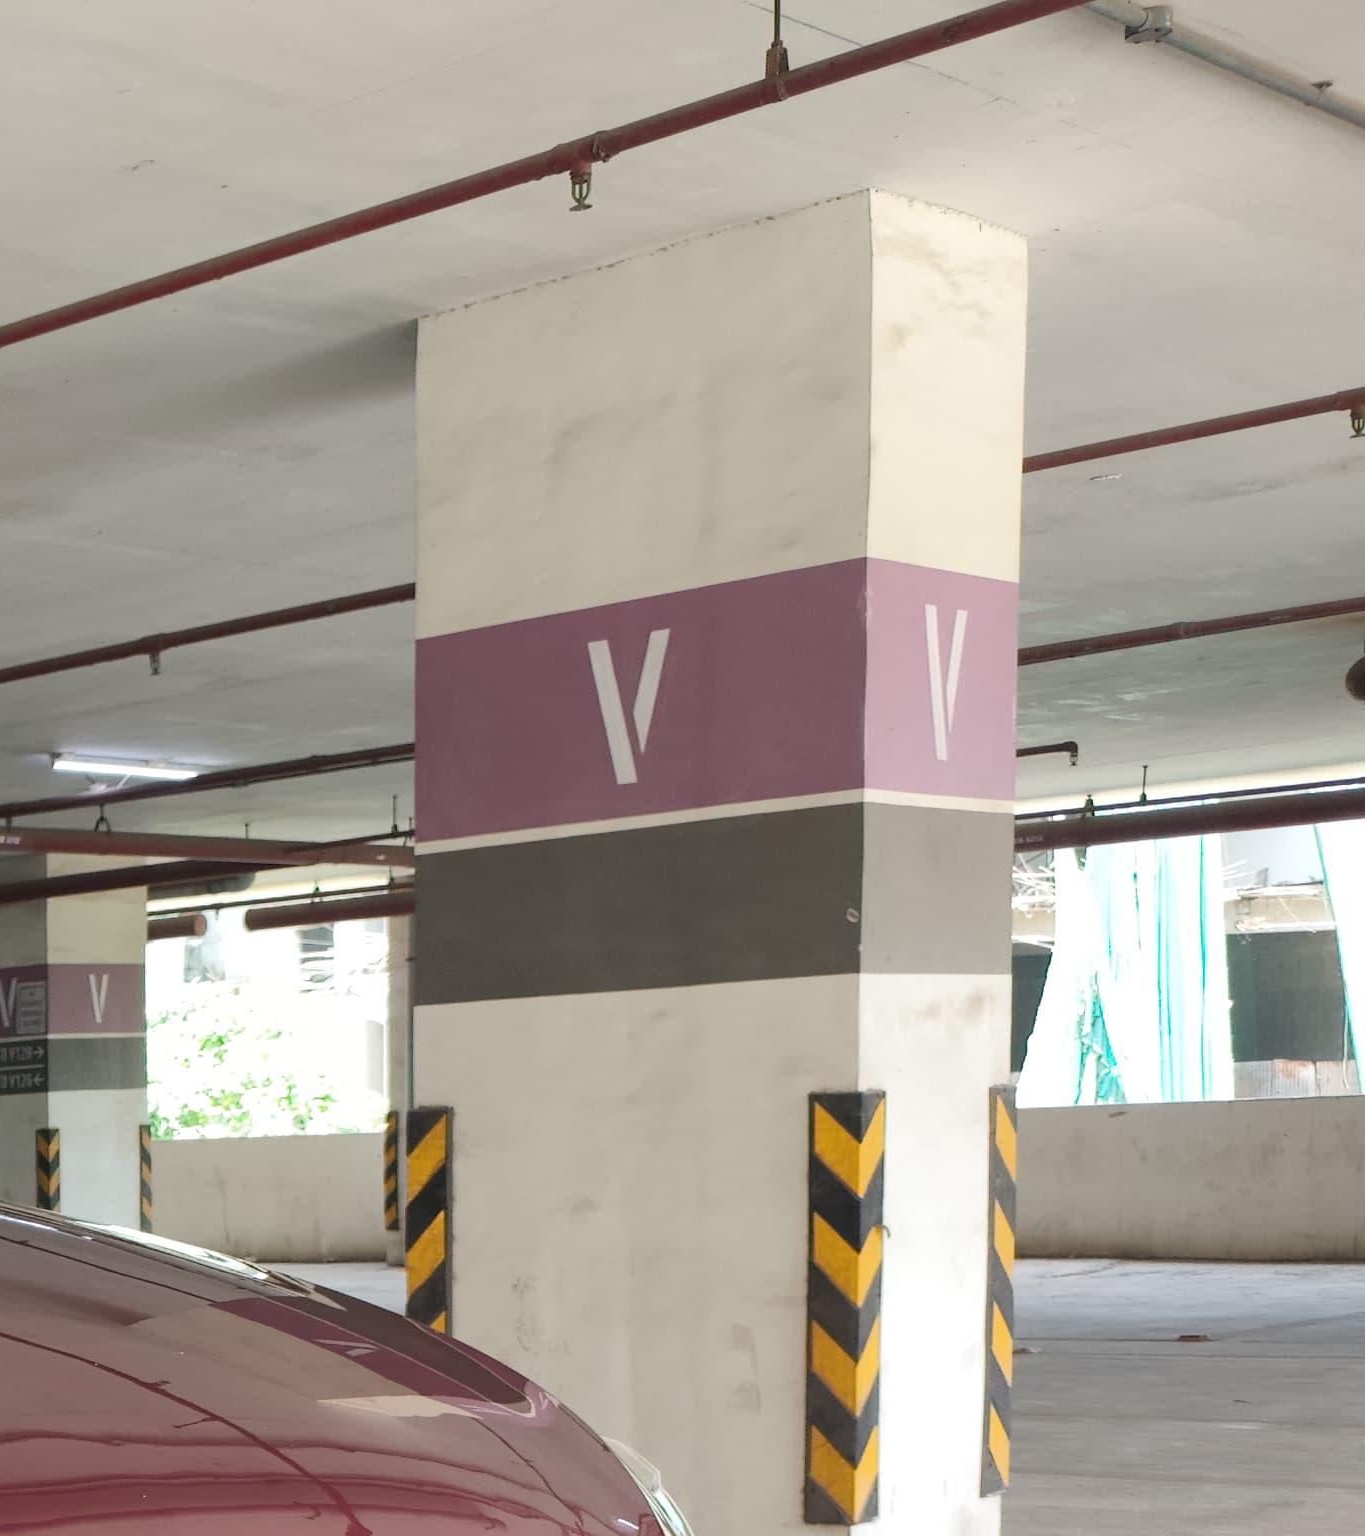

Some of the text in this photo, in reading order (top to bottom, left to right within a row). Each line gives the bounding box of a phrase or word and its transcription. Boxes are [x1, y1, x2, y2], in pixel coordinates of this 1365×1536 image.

[587, 628, 671, 785] V
[924, 604, 968, 761] V
[88, 973, 110, 1024] V
